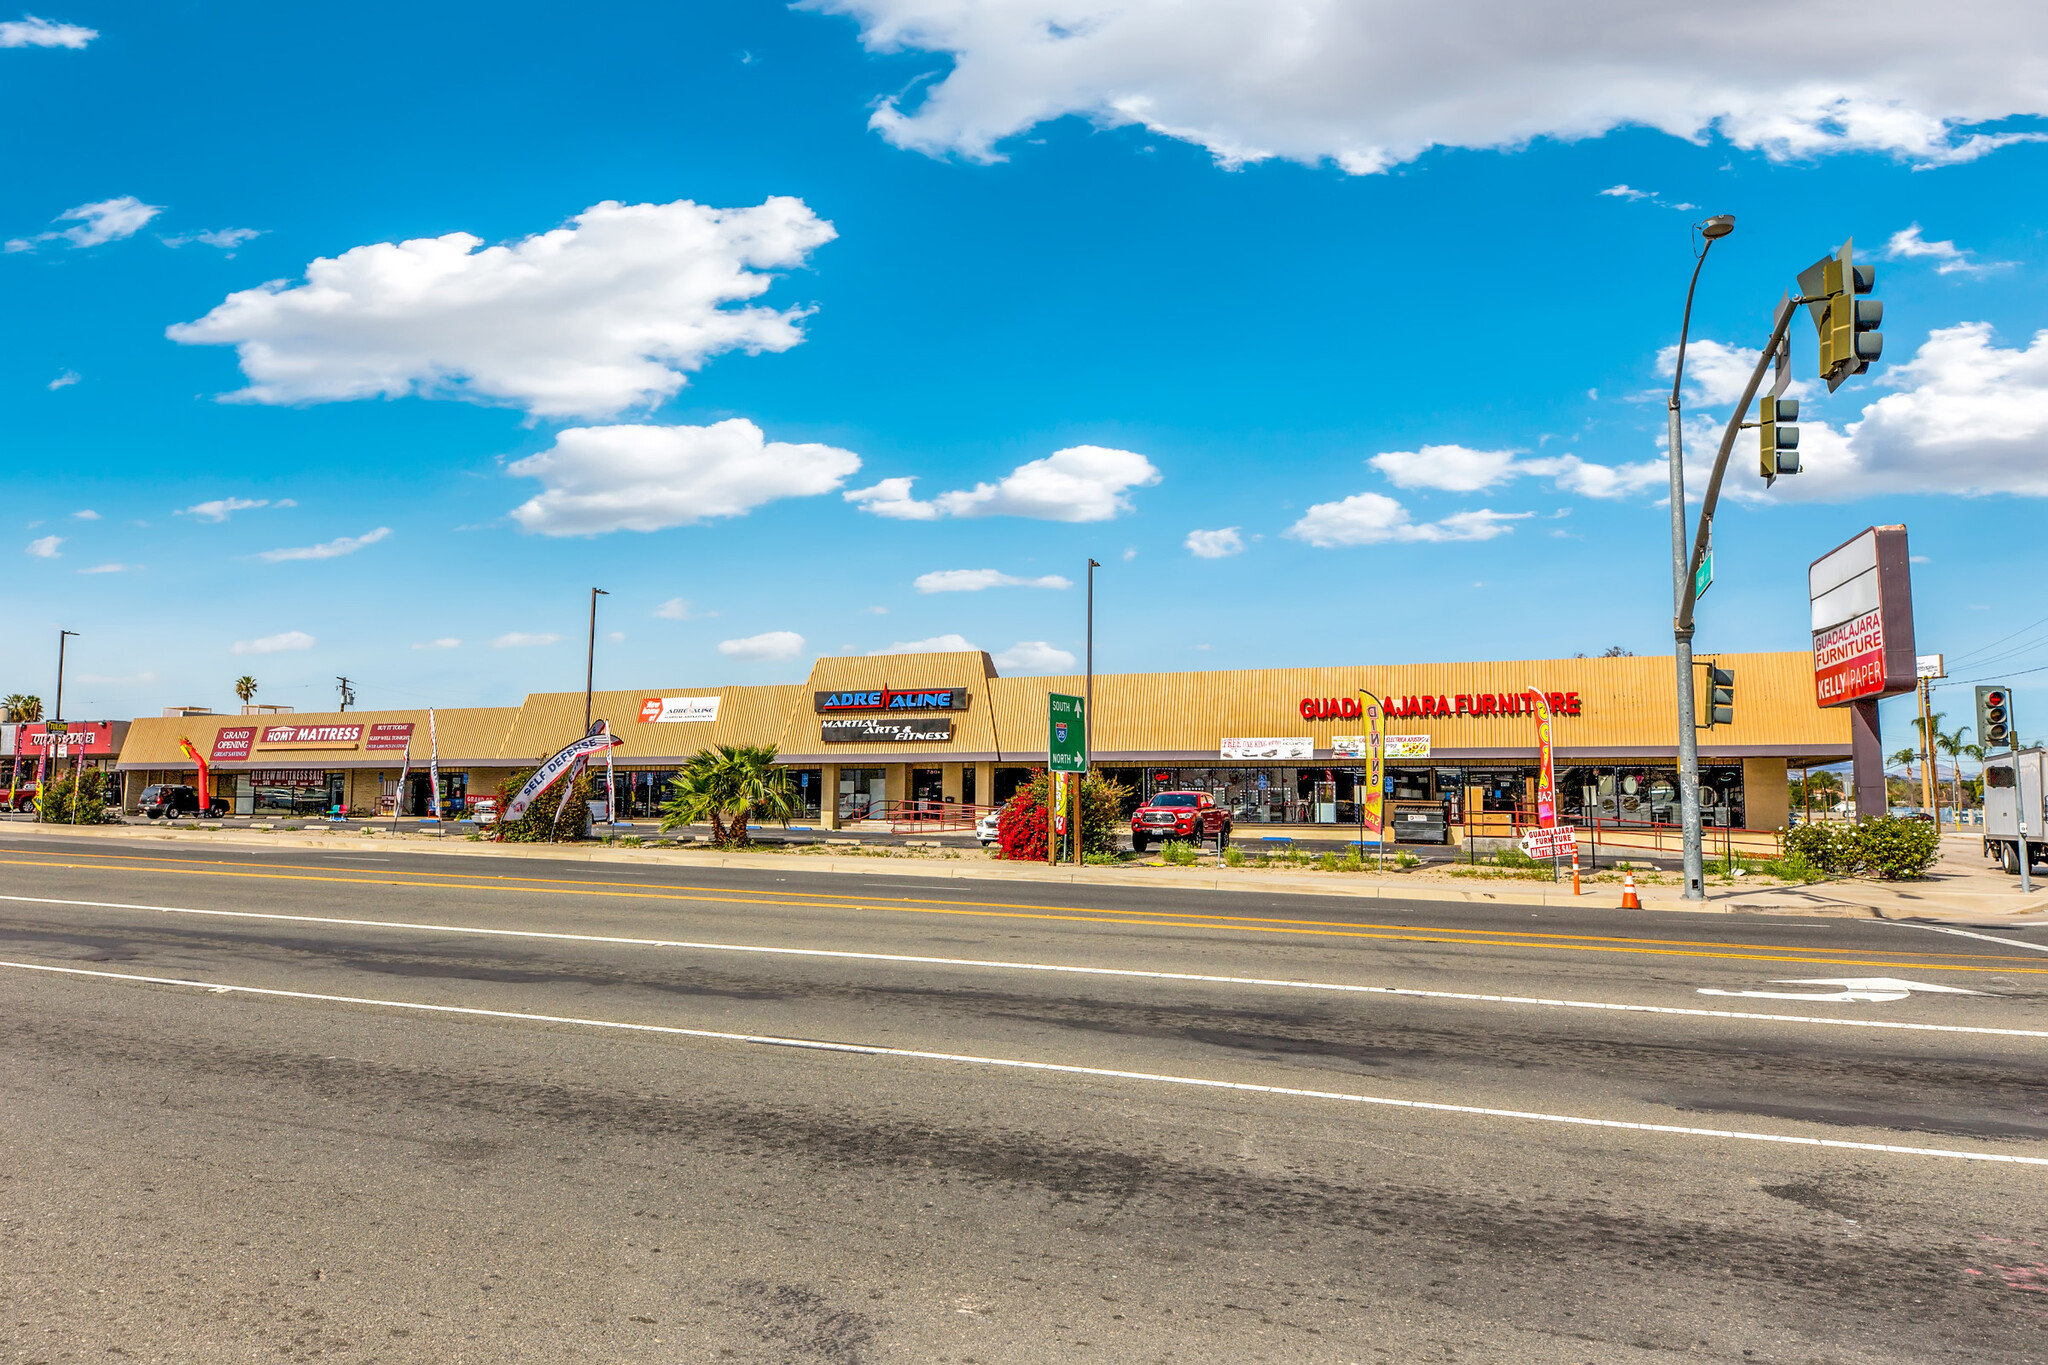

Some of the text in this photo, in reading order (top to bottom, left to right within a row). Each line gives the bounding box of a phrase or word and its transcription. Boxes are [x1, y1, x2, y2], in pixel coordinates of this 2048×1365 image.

[1815, 613, 1880, 652] GUADALAJARA
[1816, 630, 1882, 668] FURNITURE
[1818, 660, 1882, 700] KELLY PAPER
[823, 683, 951, 710] ADRENALINE
[1052, 700, 1070, 713] SOUTH
[1300, 692, 1580, 719] GUADAAJARA FURNITRE
[821, 719, 880, 729] MARTIAL
[863, 725, 912, 735] ARTS &
[223, 731, 250, 740] GRAND
[267, 727, 360, 742] HOMY MATTRESS
[894, 732, 950, 741] FITNESS
[217, 741, 248, 749] OPENING
[1222, 739, 1242, 748] FREE
[1052, 752, 1072, 764] NORTH
[523, 770, 547, 797] SELF
[547, 738, 597, 773] DEFENSE
[251, 770, 262, 780] ALL
[276, 770, 308, 780] MATTRESS
[308, 770, 324, 780] SALE
[1529, 826, 1574, 839] GUADALAJARA
[1535, 834, 1572, 845] FURNTURE
[1561, 844, 1573, 854] SAL
